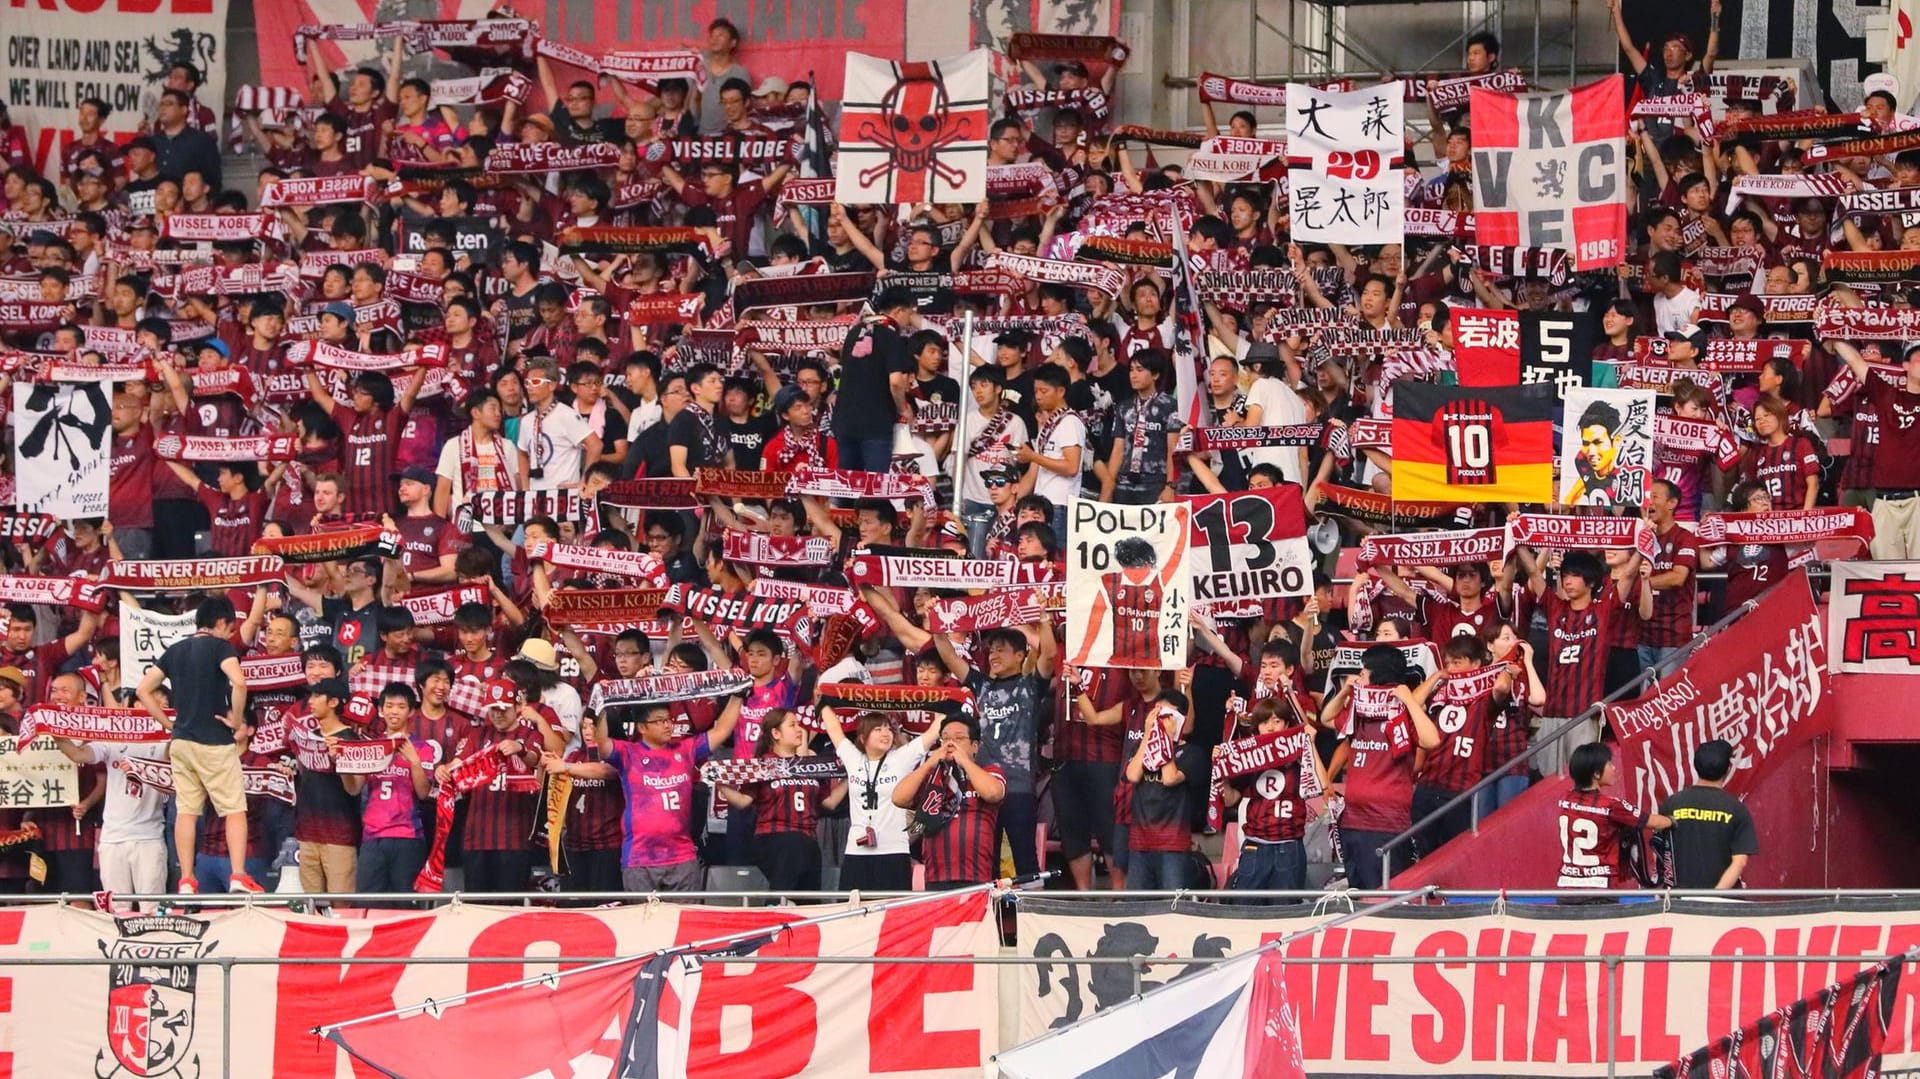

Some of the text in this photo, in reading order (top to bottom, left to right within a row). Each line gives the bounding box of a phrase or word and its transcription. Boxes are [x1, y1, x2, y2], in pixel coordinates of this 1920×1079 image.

[9, 35, 139, 74] OVER LAND AND SEA
[1482, 71, 1525, 91] KOBE
[9, 78, 31, 105] WE
[36, 82, 70, 109] WILL
[1008, 87, 1067, 107] VISSEL
[1298, 97, 1395, 140] 大森
[1526, 94, 1566, 150] K
[346, 138, 361, 152] 21
[672, 140, 786, 158] VISSEL KOBE
[1326, 149, 1381, 179] 29
[1474, 143, 1617, 208] V C
[1294, 186, 1390, 230] 晃太郎
[1841, 193, 1907, 210] VISSEL
[173, 216, 251, 230] VISSEL KOBE
[593, 229, 690, 245] VISSEL KOBE
[1579, 240, 1618, 262] 1995
[1830, 258, 1918, 271] VISSEL KOBE
[679, 298, 698, 315] 34
[1700, 297, 1717, 311] WE
[1281, 310, 1321, 327] SHALL
[758, 327, 815, 343] WE ARE
[1345, 328, 1381, 345] SHALL
[1458, 317, 1519, 349] 岩波
[1540, 320, 1573, 363] 5
[1627, 368, 1669, 383] NEVER
[348, 433, 388, 444] Rakuten
[1205, 424, 1322, 440] VISSEL KOBE
[1670, 421, 1708, 440] KOBE
[189, 439, 226, 451] VISSEL
[272, 439, 288, 454] 10
[1280, 438, 1316, 446] KOBE
[1448, 424, 1490, 468] 10
[355, 448, 371, 466] 12
[1616, 398, 1652, 505] 慶治朗
[723, 471, 769, 485] VISSEL
[1458, 469, 1486, 477] PODOLSKI
[1757, 463, 1797, 477] Rakuten
[1336, 492, 1441, 518] VISSEL KOBE
[1074, 502, 1167, 534] POLDI
[1455, 506, 1472, 526] 10
[1735, 512, 1850, 535] VISSEL KOBE
[1192, 495, 1276, 572] 13
[278, 534, 367, 555] VISSEL KOBE
[558, 542, 602, 558] VISSEL
[1379, 535, 1503, 559] VISSEL KOBE
[1077, 541, 1110, 570] 10
[1423, 555, 1457, 564] TOGETHER
[113, 559, 257, 578] WE NEVER FORGET
[894, 559, 1007, 577] VISSEL KOBE
[1192, 566, 1304, 600] KEIJIRO
[565, 593, 665, 609] VISSEL KOBE
[760, 583, 845, 605] VISSEL KOBE
[401, 598, 438, 614] KOBE
[687, 589, 801, 624] VISSEL KOBE
[968, 595, 1006, 614] VISSEL
[975, 610, 1006, 629] KOBE
[1130, 618, 1144, 632] 10
[1163, 588, 1185, 656] 小次郎
[343, 623, 355, 640] R
[348, 646, 365, 662] 12
[1559, 645, 1581, 664] 22
[245, 664, 278, 679] WE ARE
[560, 658, 581, 676] 29
[654, 675, 674, 693] AND
[836, 686, 952, 703] VISSEL KOBE
[1611, 668, 1700, 740] Progreso!
[40, 710, 156, 732] VISSEL KOBE
[907, 710, 931, 724] WE
[1445, 710, 1458, 726] R
[744, 721, 761, 742] 13
[1393, 724, 1409, 742] 21
[1238, 735, 1257, 751] 1995
[1453, 736, 1475, 758] 15
[344, 745, 384, 762] KOBE
[1228, 743, 1275, 774] SHOT
[1354, 752, 1366, 768] 21
[795, 762, 837, 775] KOBE
[642, 772, 688, 787] Rakuten
[1265, 776, 1277, 793] R
[379, 781, 392, 801] 5
[576, 794, 586, 814] 4
[661, 792, 681, 811] 12
[793, 791, 805, 812] 6
[1274, 800, 1293, 819] 12
[1570, 801, 1611, 816] Kawasaki
[1673, 807, 1733, 824] SECURITY
[1559, 814, 1600, 867] 12
[1585, 865, 1611, 876] KOBE
[118, 944, 194, 960] KOBE
[115, 964, 190, 987] 20 09
[276, 898, 990, 1079] KOBE
[1411, 925, 1684, 1066] SHALL
